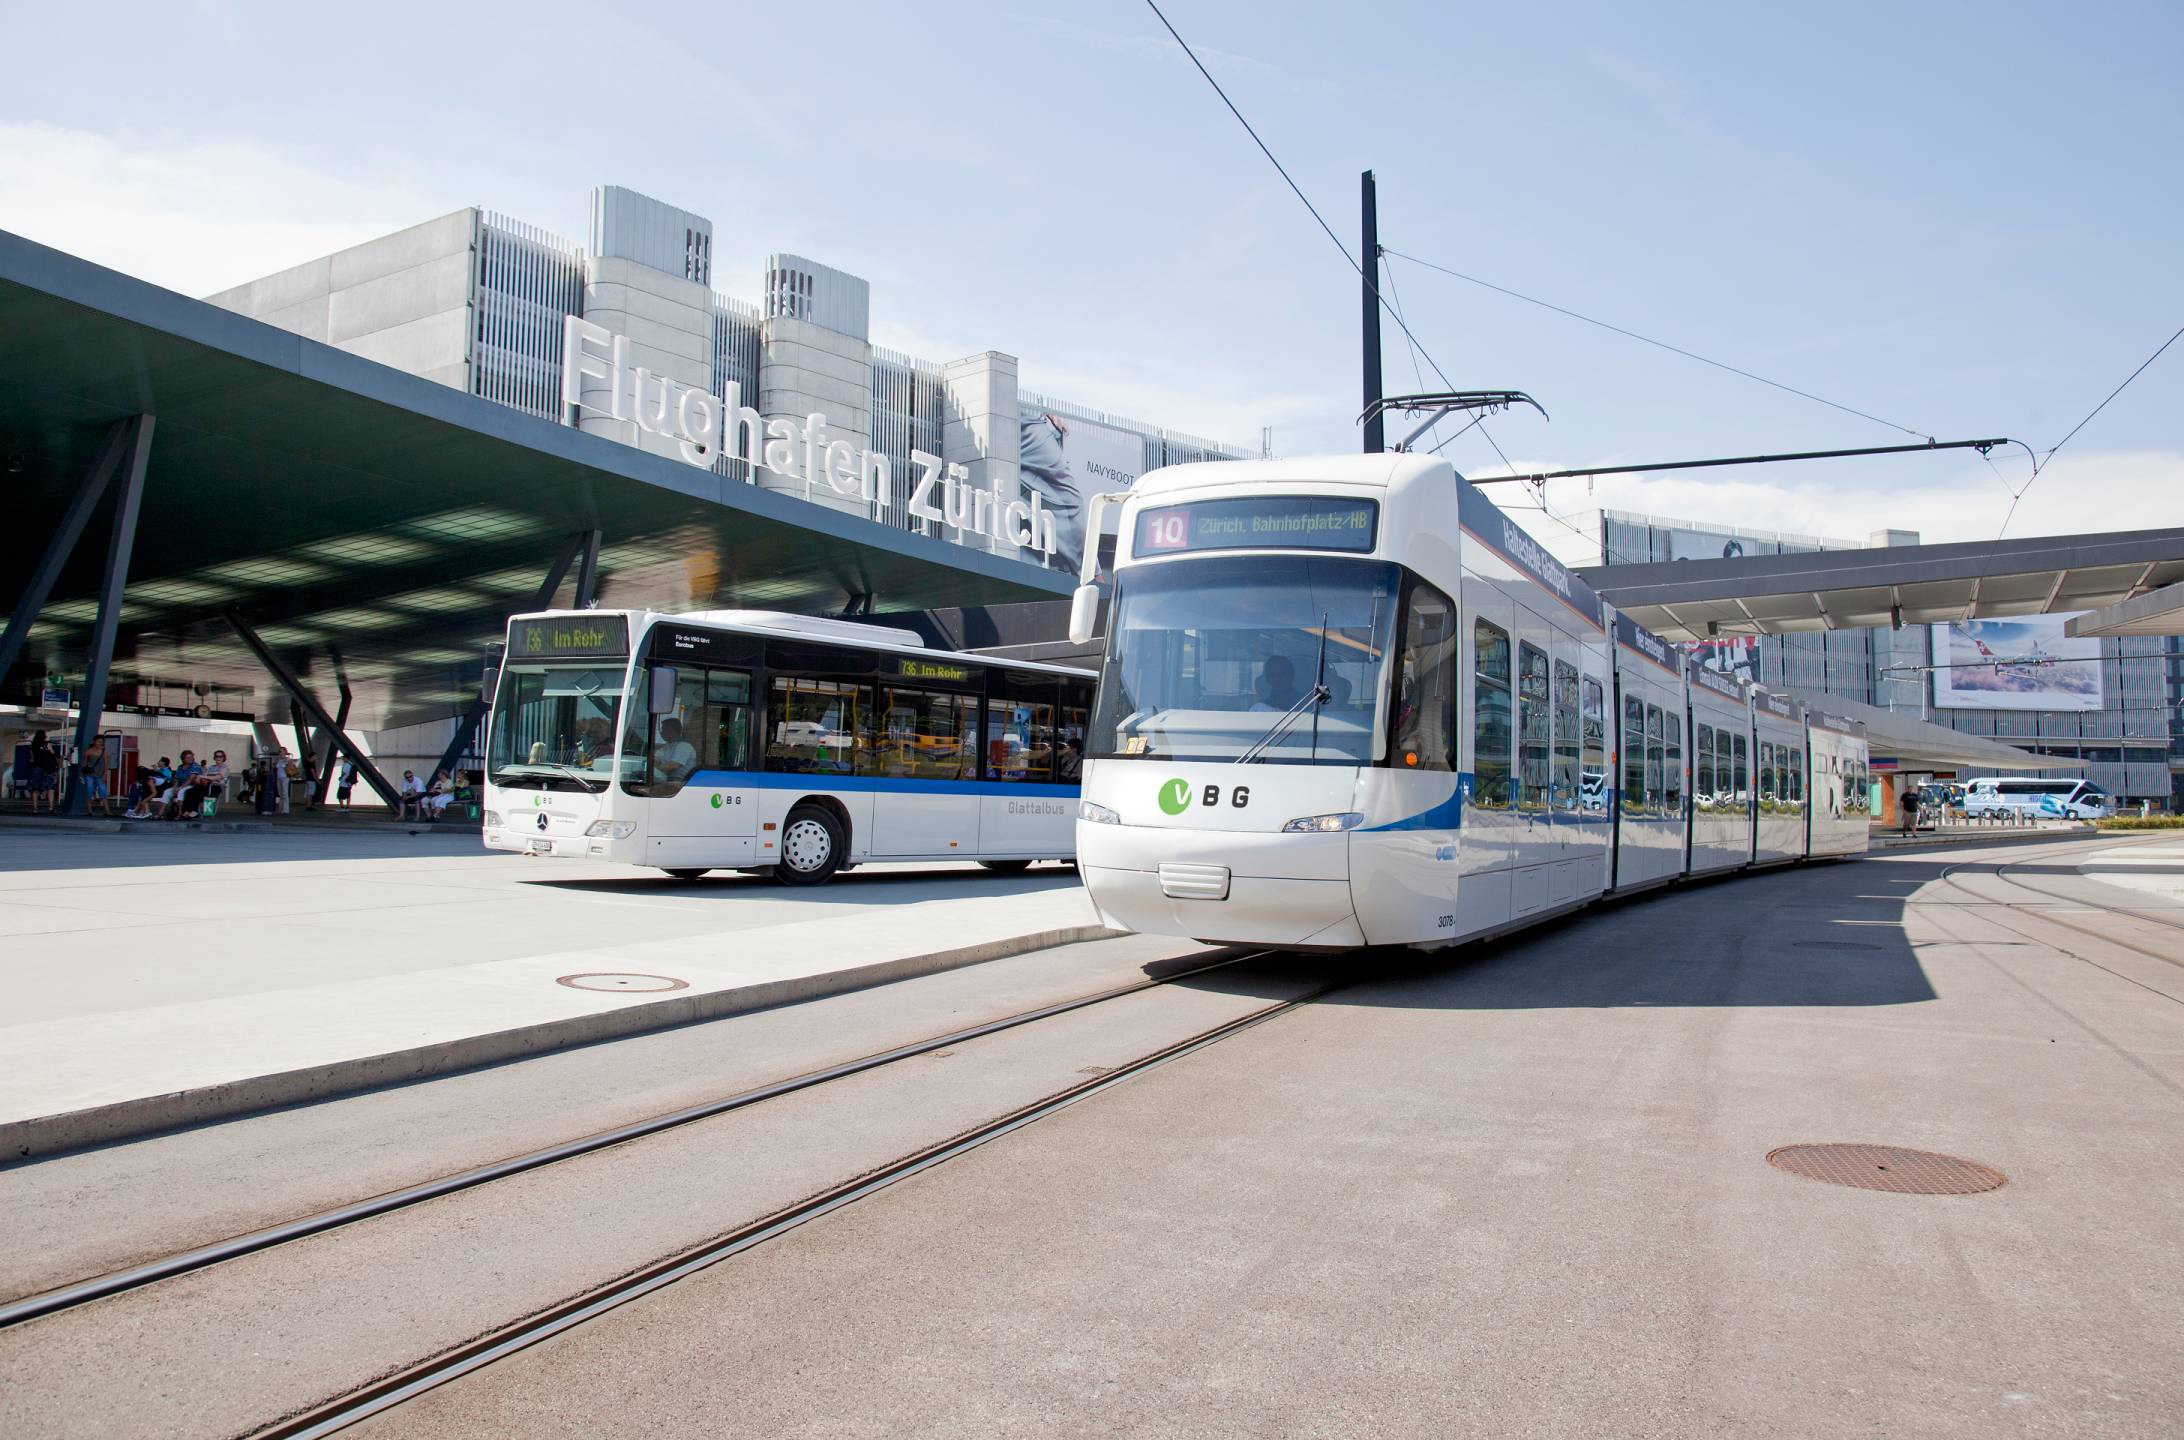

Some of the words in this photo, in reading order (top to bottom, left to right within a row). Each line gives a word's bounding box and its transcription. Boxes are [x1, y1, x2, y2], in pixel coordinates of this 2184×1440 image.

[563, 314, 891, 506] Flughafen
[908, 449, 1057, 554] Zürich
[1086, 460, 1135, 487] NAVYBOOT
[1151, 515, 1184, 545] 10
[1252, 511, 1368, 534] Bahnhofplatz/HB
[1502, 518, 1542, 577] Haltestelle
[526, 627, 542, 651] 736
[555, 630, 571, 648] Im
[573, 628, 604, 648] Rohr
[902, 660, 917, 676] 736
[922, 664, 936, 677] Im
[937, 666, 962, 679] Rohr
[203, 801, 213, 813] K
[1008, 801, 1065, 815] Glattalbus
